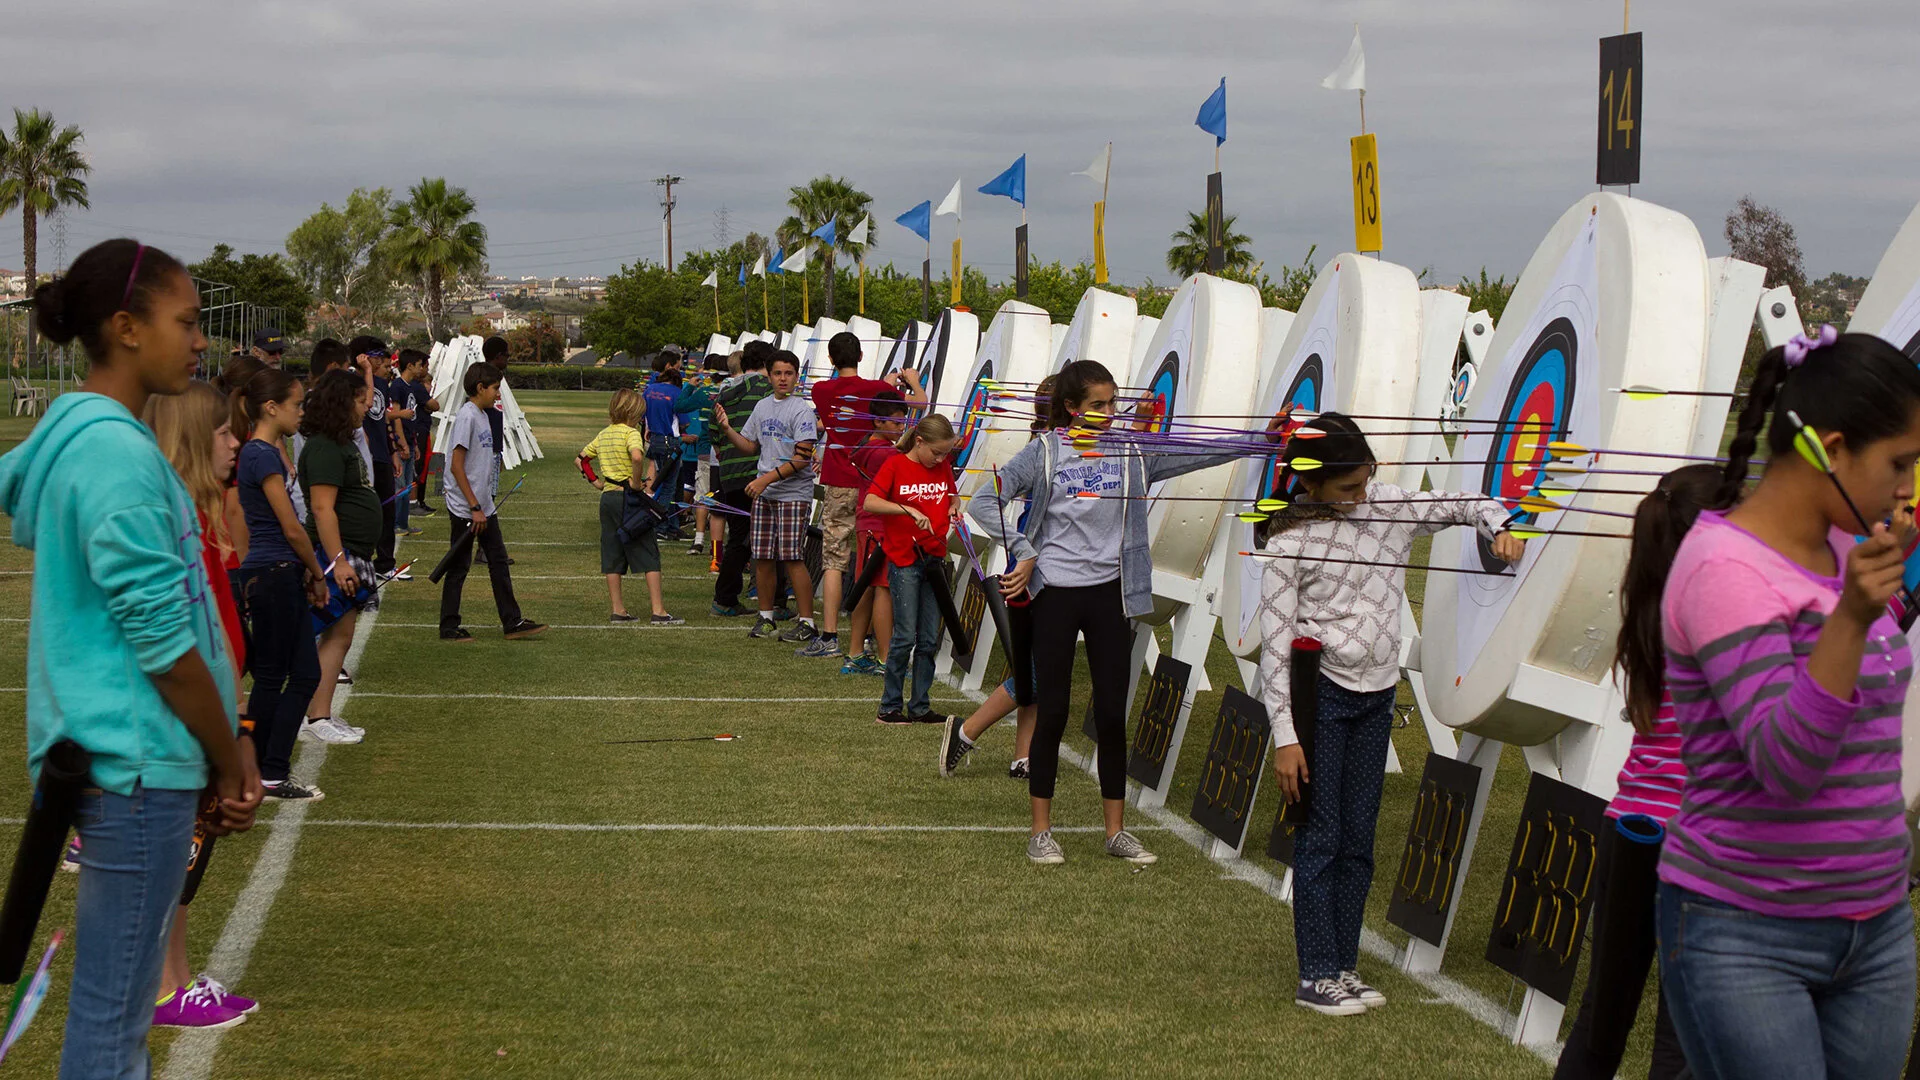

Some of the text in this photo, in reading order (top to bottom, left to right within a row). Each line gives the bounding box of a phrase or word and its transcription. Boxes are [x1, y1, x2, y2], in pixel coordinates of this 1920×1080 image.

[1603, 67, 1634, 150] 14
[1209, 194, 1222, 248] 12
[1357, 161, 1377, 225] 13
